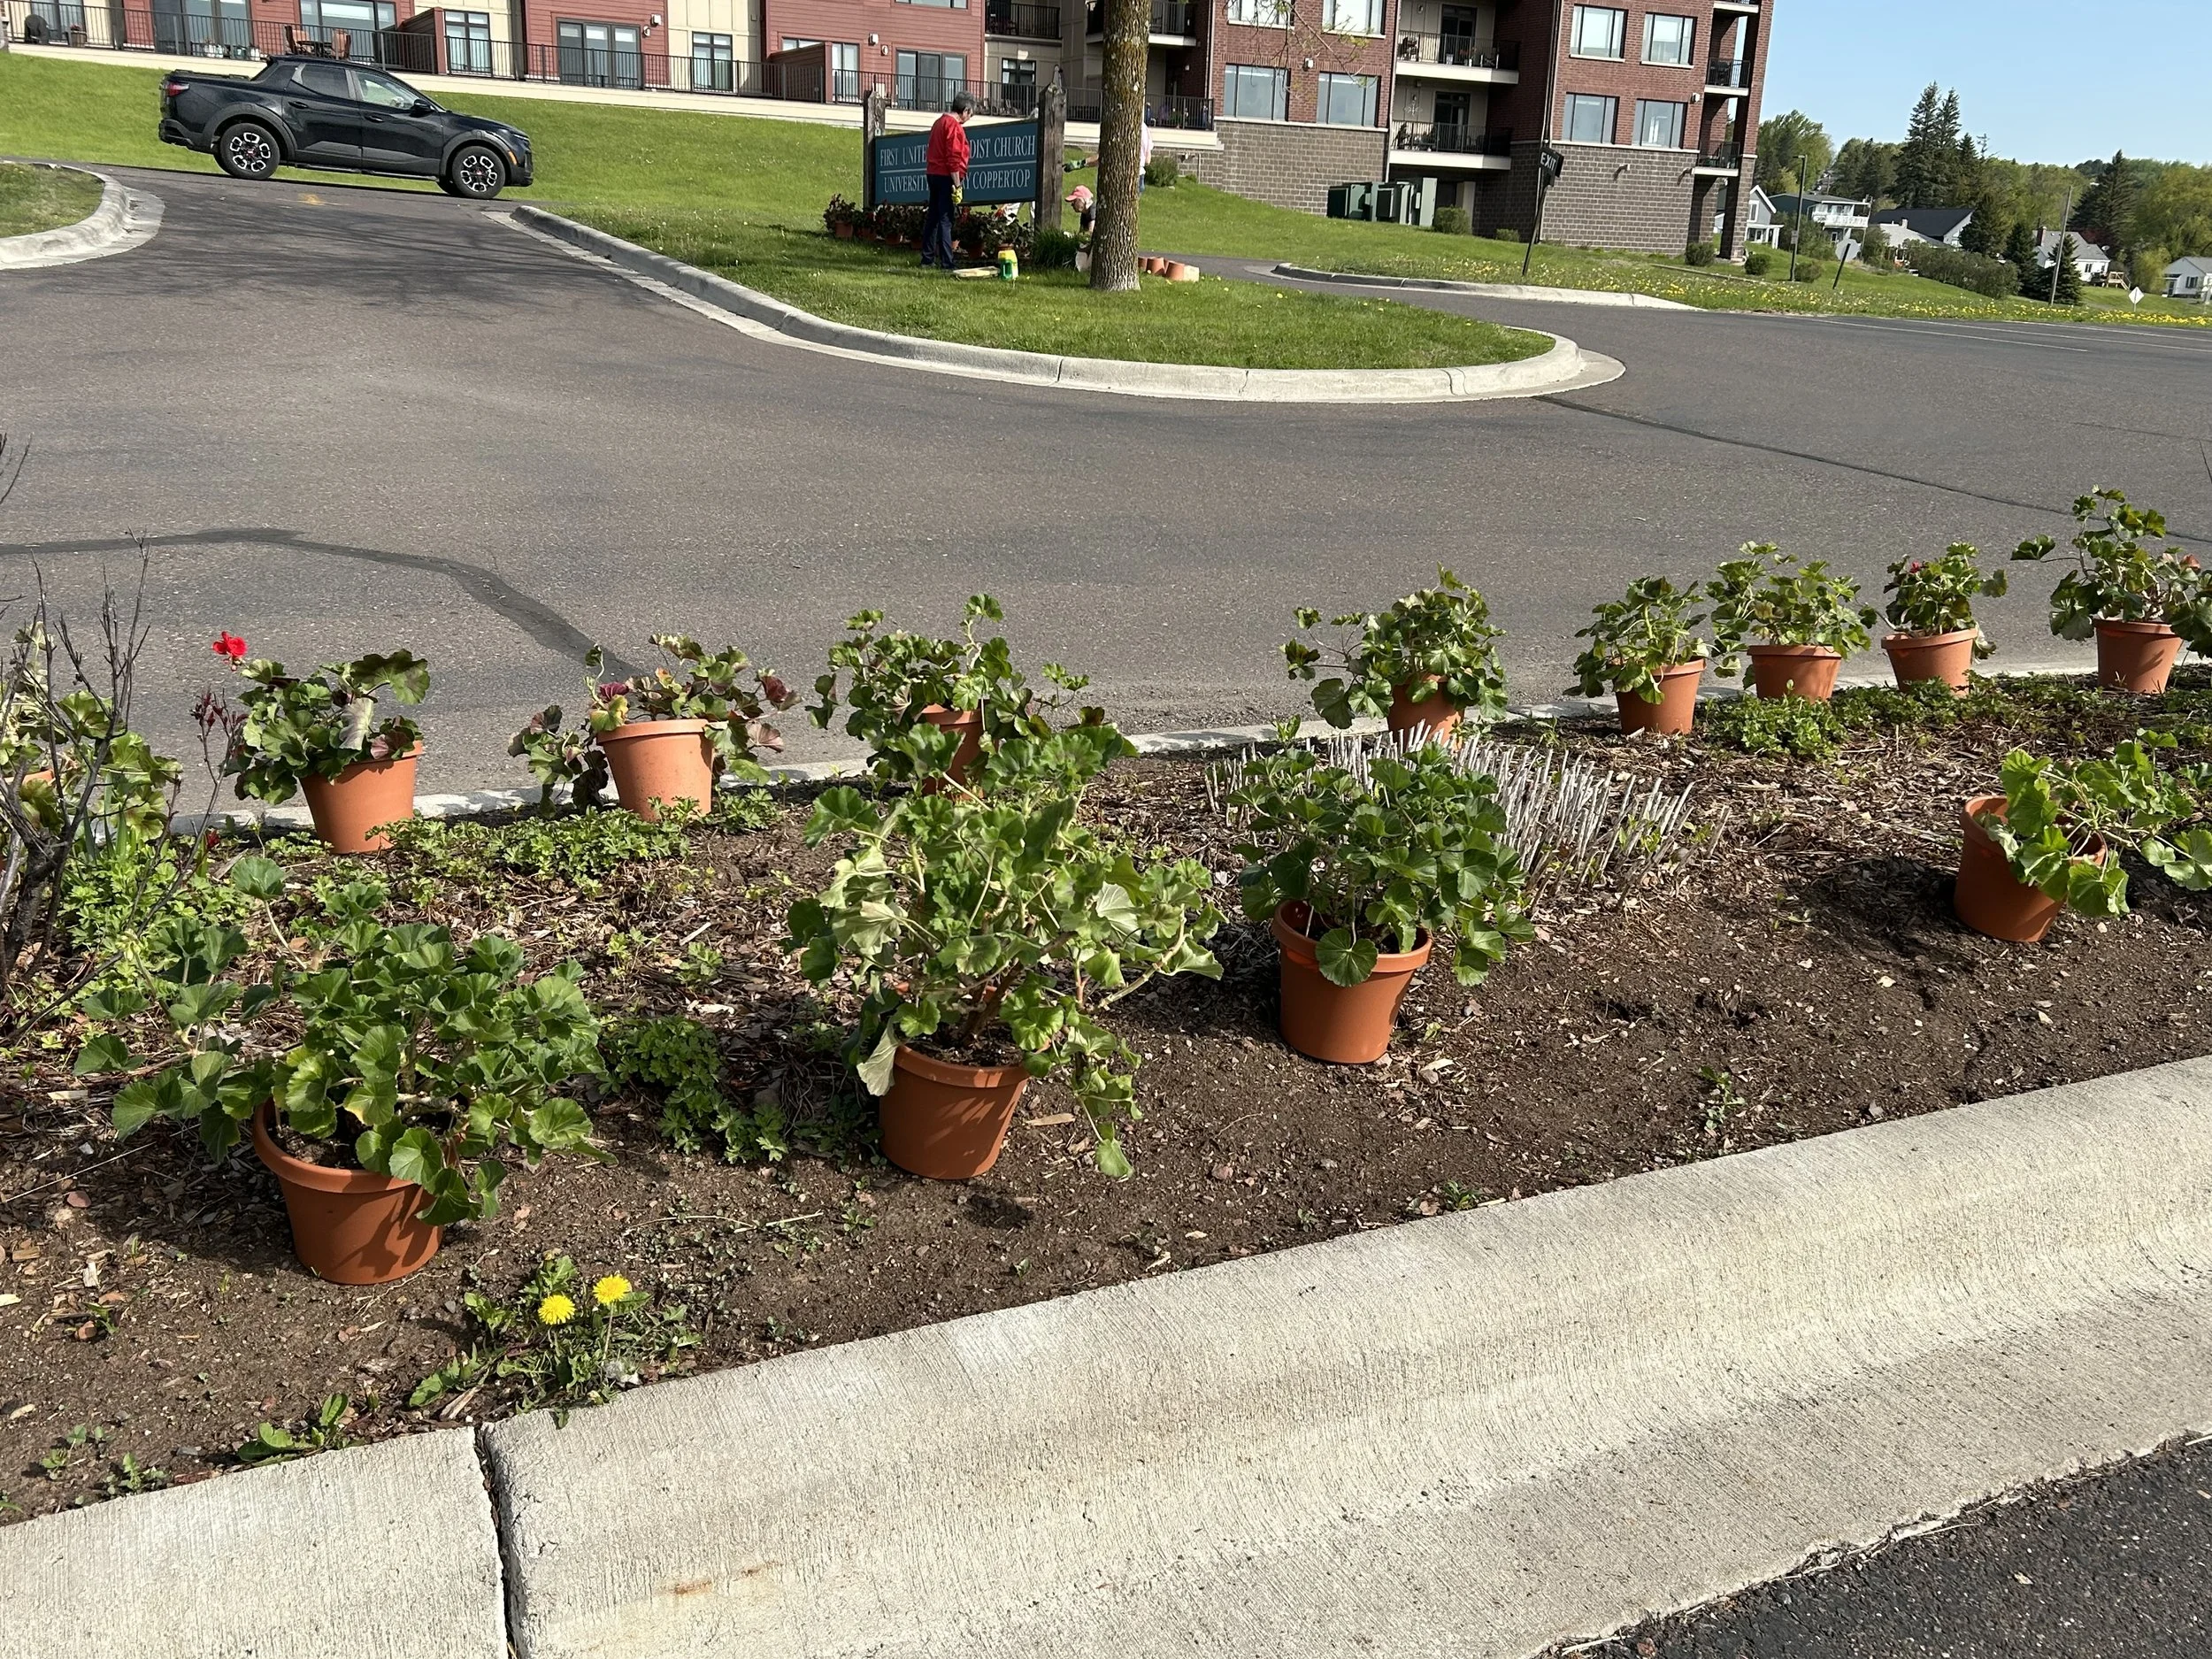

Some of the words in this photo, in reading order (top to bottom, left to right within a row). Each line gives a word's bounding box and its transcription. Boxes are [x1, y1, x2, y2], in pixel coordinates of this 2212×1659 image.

[879, 148, 898, 166] FIRST
[902, 143, 929, 165] UNITE
[994, 134, 1035, 157] CHURCH
[1540, 151, 1556, 171] EXIT
[972, 169, 1031, 190] COPPERTOP
